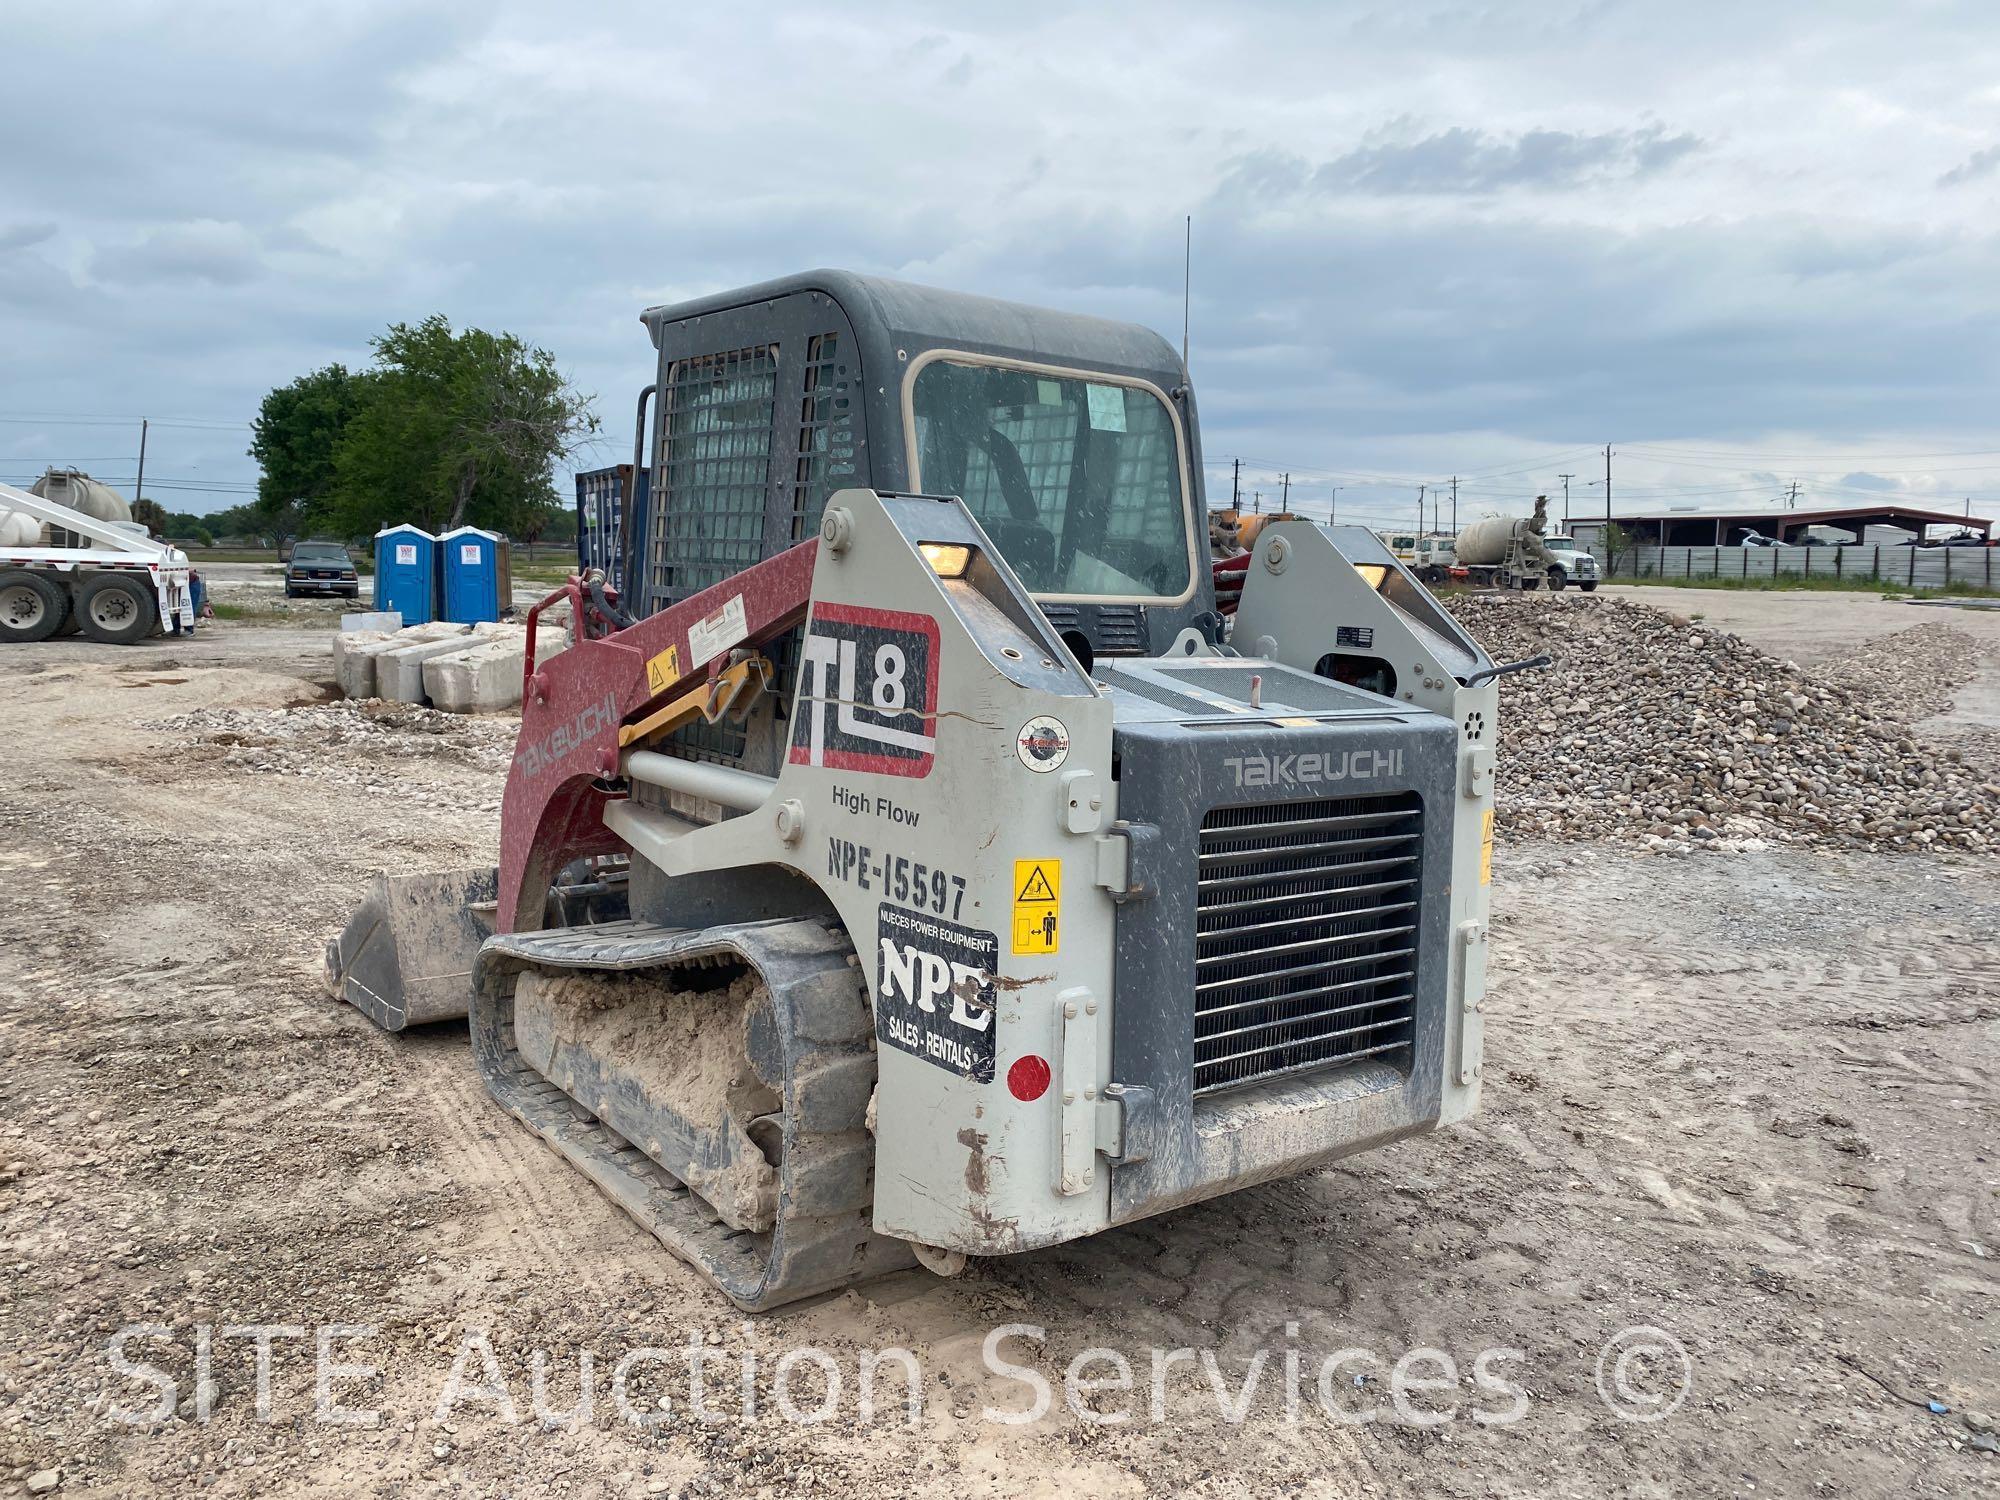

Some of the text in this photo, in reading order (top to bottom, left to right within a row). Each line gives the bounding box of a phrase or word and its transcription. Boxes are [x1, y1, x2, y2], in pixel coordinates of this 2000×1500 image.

[804, 634, 935, 767] TL8
[1223, 749, 1404, 787] TAKEUCHI
[832, 785, 920, 827] High Flow
[828, 836, 967, 921] NPE-15597
[880, 910, 993, 953] NUECES POWER EQUIPMENT
[880, 937, 991, 1032] NPE
[889, 1016, 918, 1049] SALES
[926, 1031, 971, 1071] RENTALS
